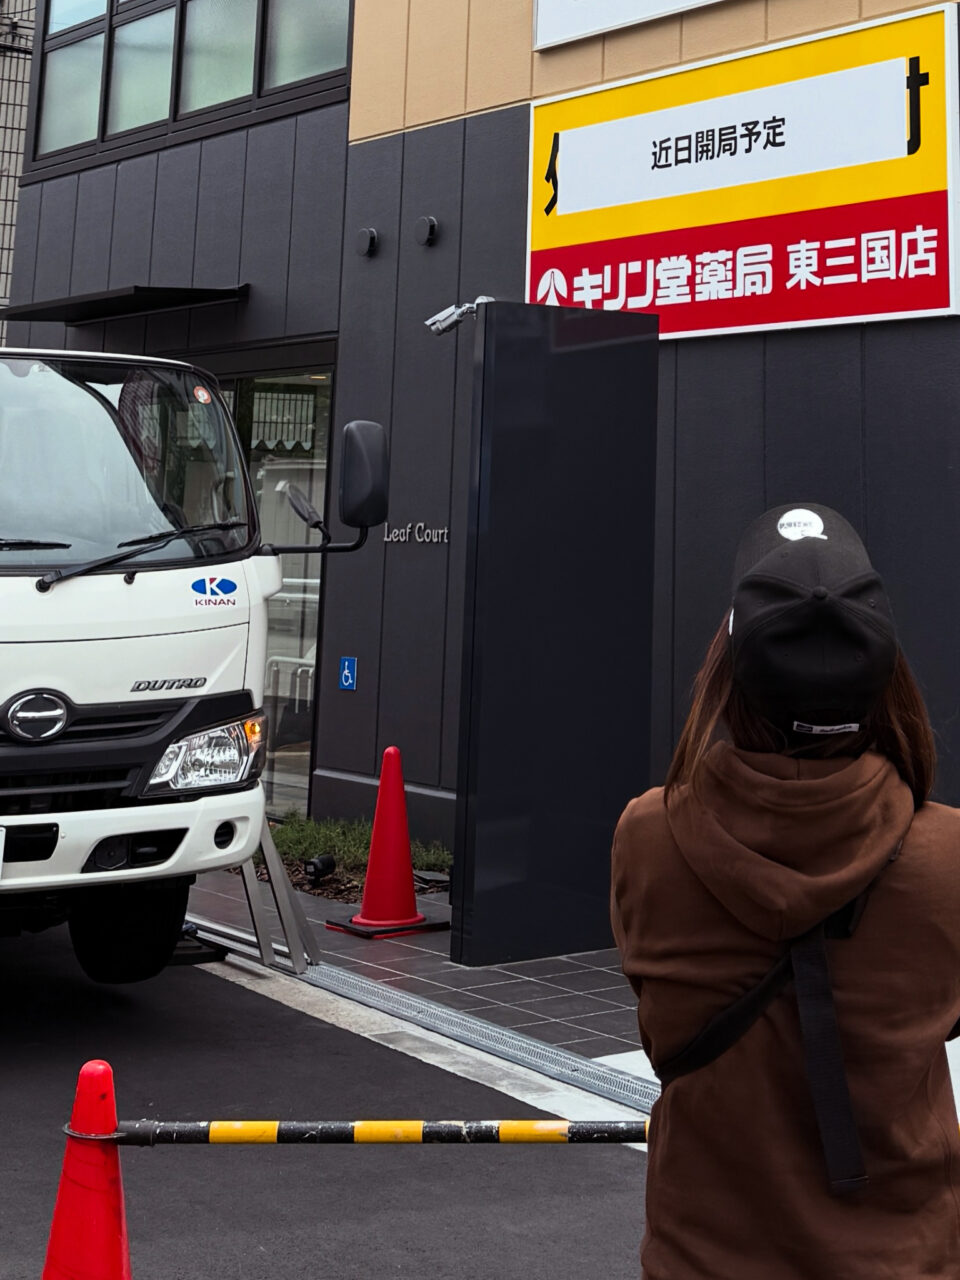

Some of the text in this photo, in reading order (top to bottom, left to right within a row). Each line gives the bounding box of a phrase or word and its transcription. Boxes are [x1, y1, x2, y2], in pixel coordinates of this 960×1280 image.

[651, 115, 787, 171] 近日開局予定
[573, 224, 939, 311] キリン堂薬局 東三国店
[383, 521, 449, 543] Leaf Court
[194, 598, 237, 606] KINAN
[130, 676, 207, 693] DUTRO
